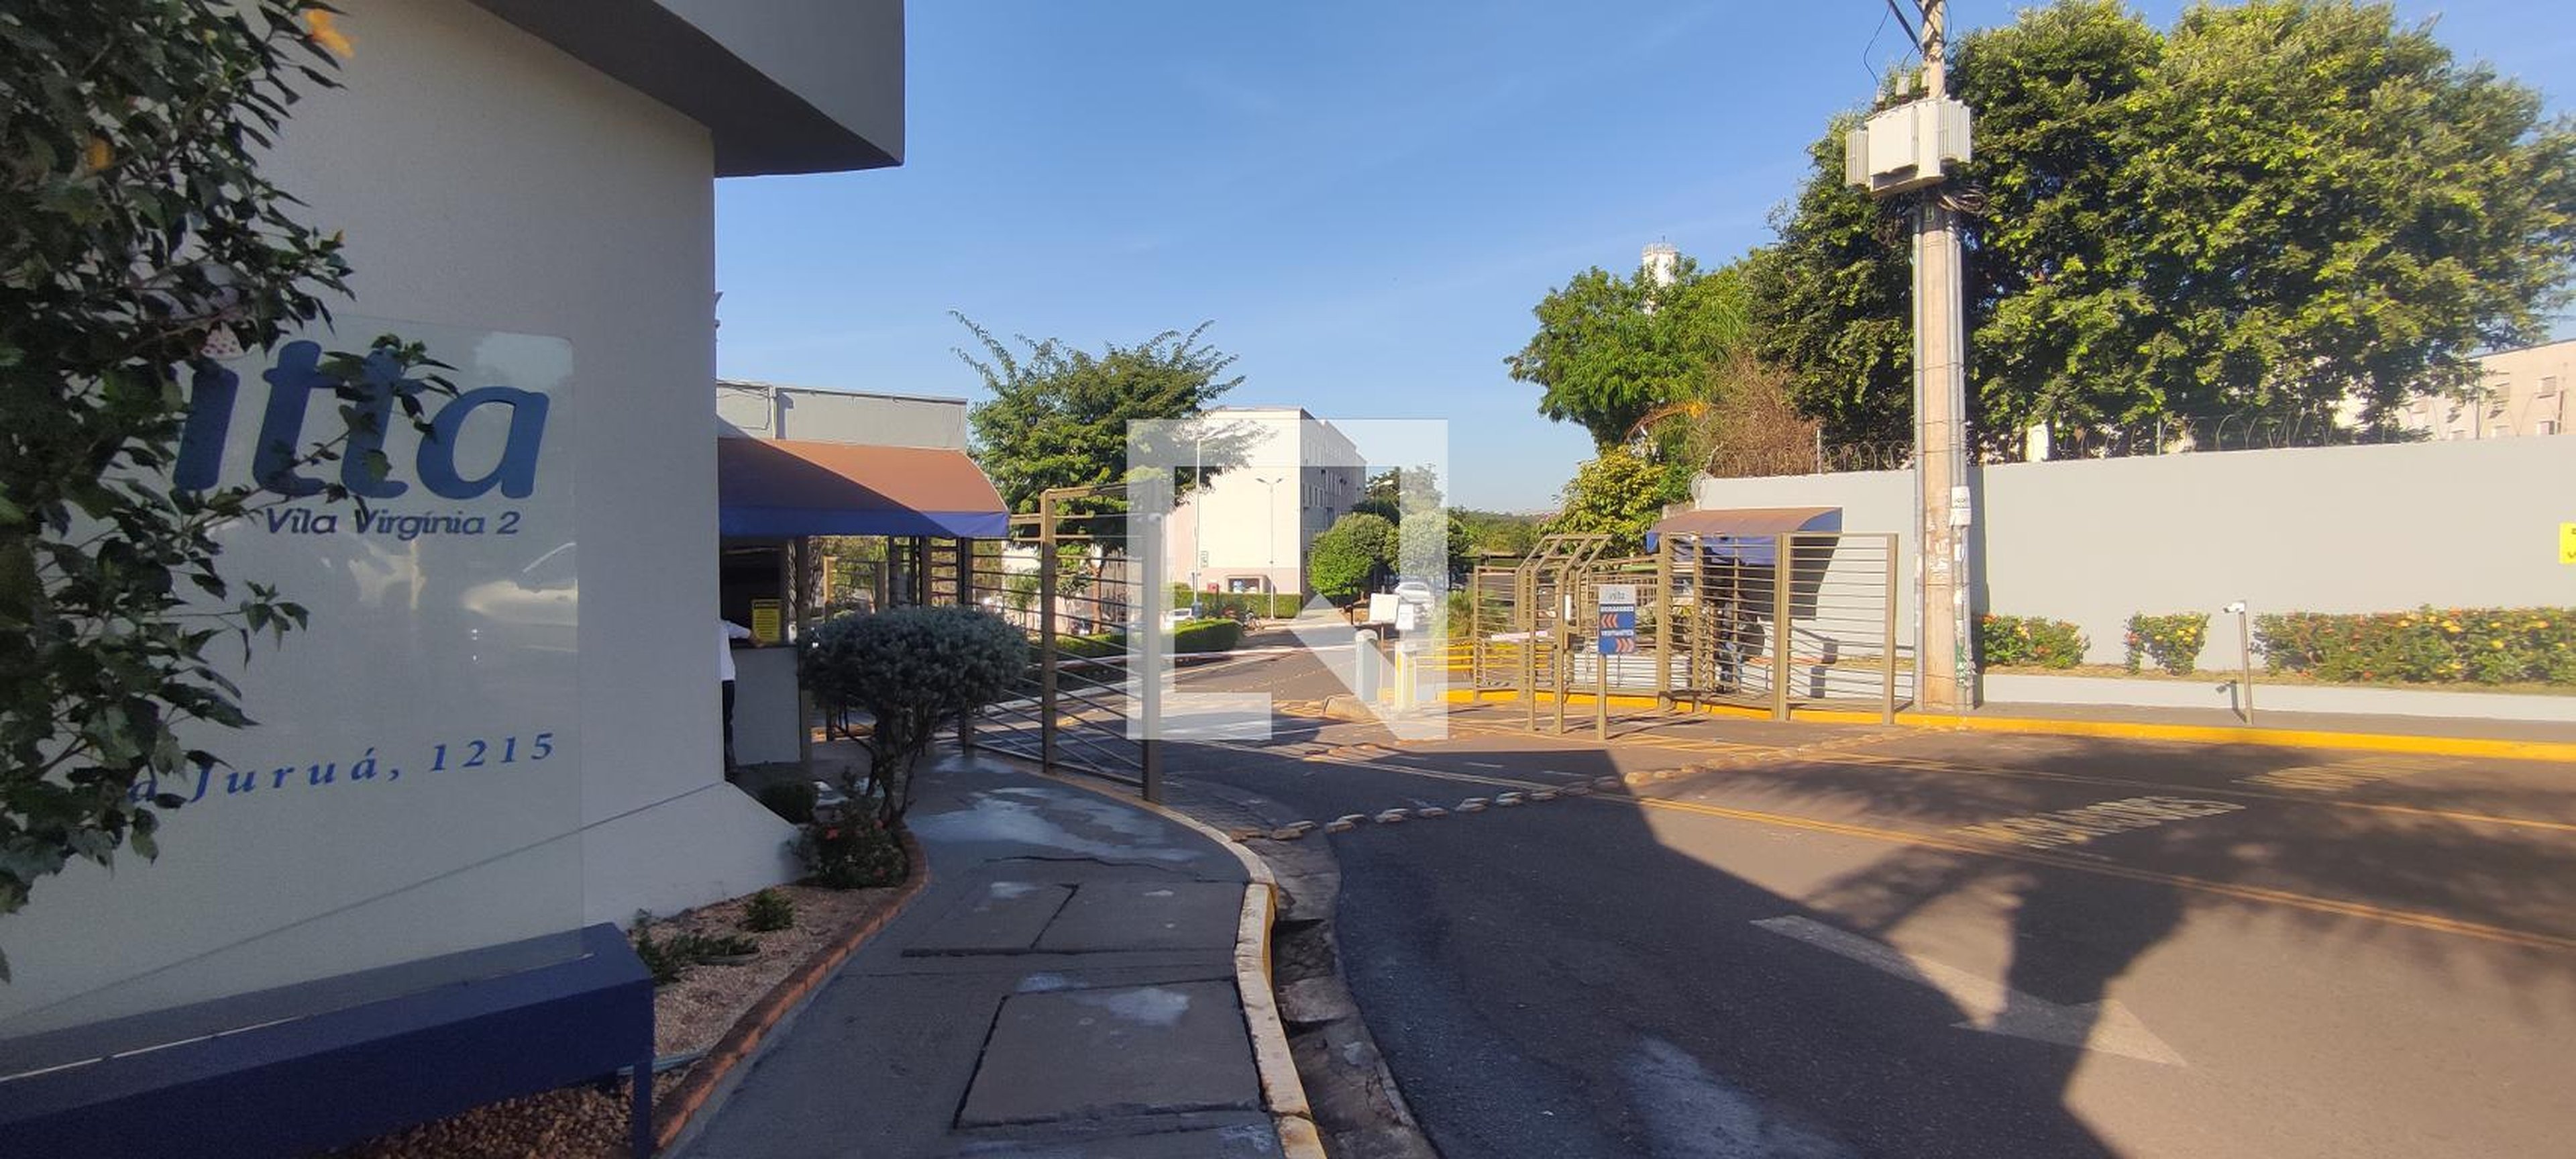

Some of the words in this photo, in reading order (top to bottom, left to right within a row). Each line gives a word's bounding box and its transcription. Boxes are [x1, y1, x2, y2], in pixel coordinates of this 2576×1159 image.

[171, 339, 550, 499] itta
[267, 508, 336, 534] Vila
[355, 509, 486, 542] Virgínia
[497, 511, 521, 534] 2
[189, 747, 400, 803] Juruá,
[431, 732, 555, 772] 1215
